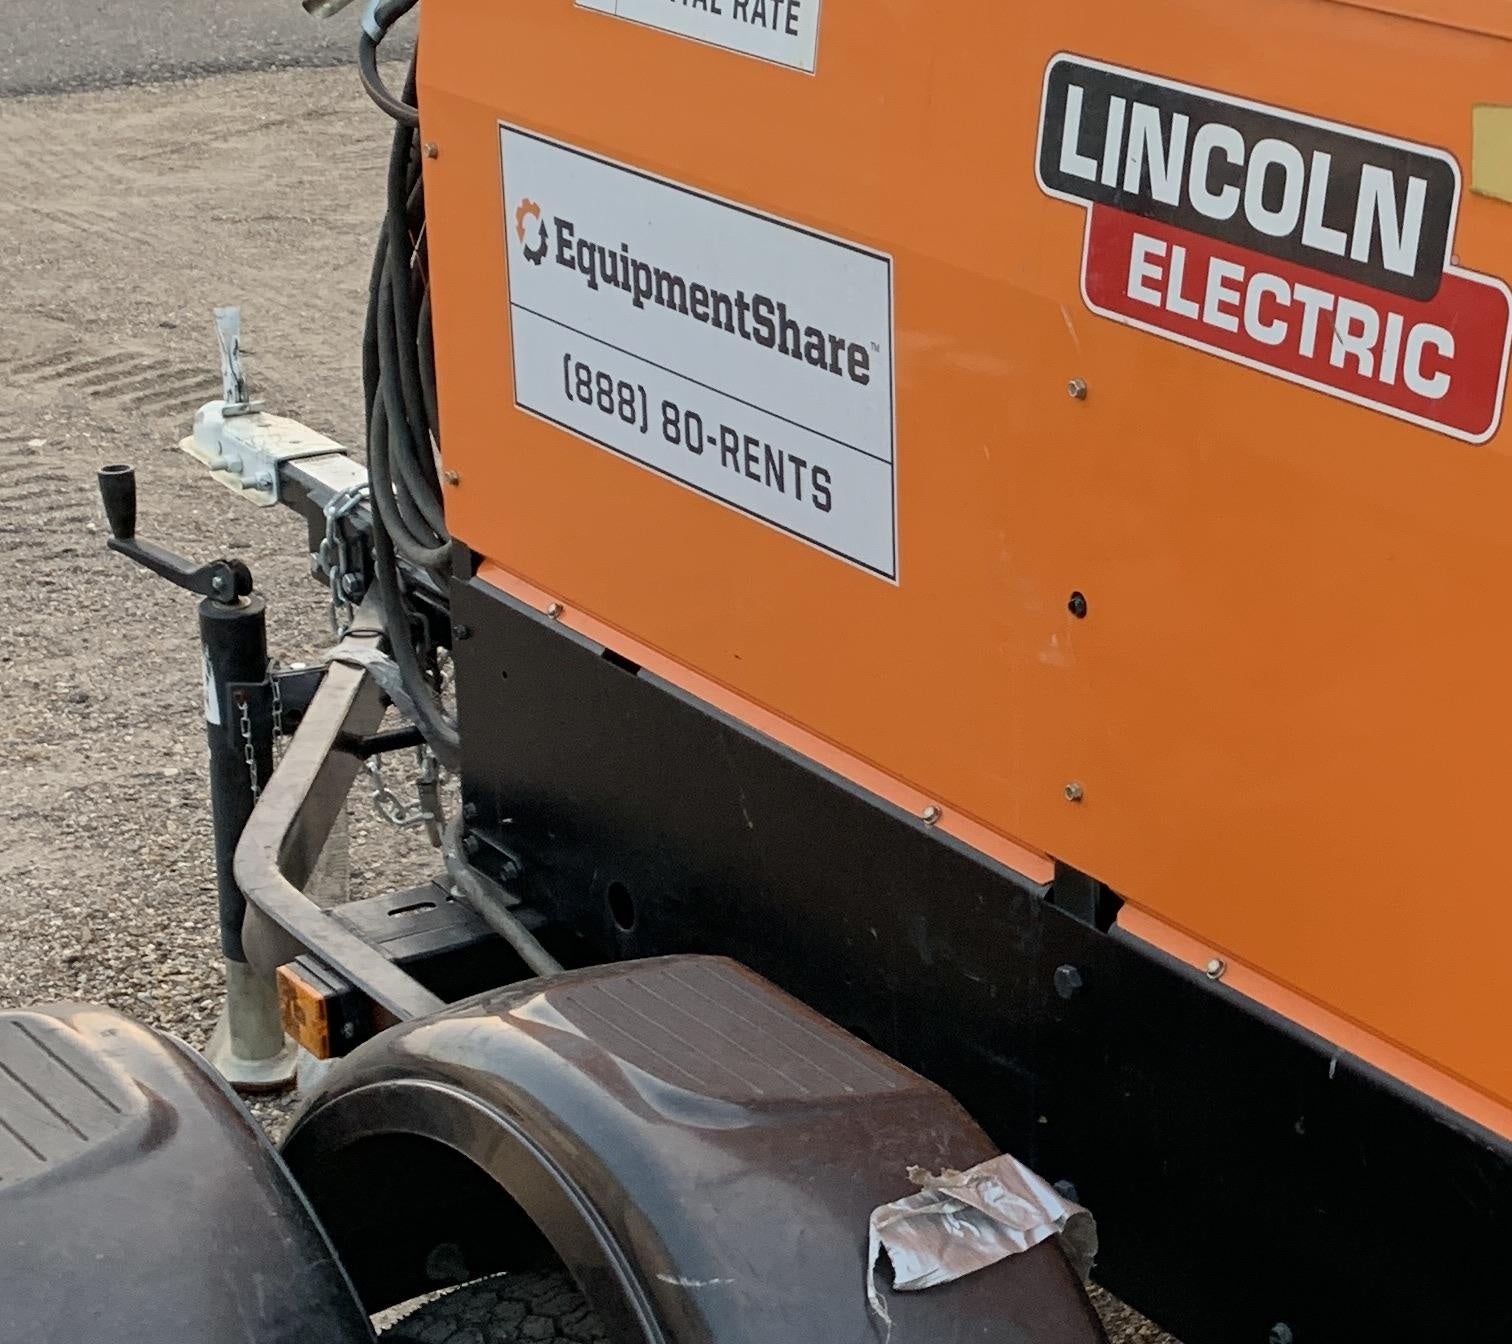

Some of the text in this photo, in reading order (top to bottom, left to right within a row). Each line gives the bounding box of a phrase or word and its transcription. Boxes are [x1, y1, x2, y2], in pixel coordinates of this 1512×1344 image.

[1059, 84, 1428, 278] LINCOLN
[554, 216, 870, 386] EquipmentShare
[1126, 232, 1456, 400] ELECTRIC
[563, 352, 833, 514] (888) 80-RENTS
